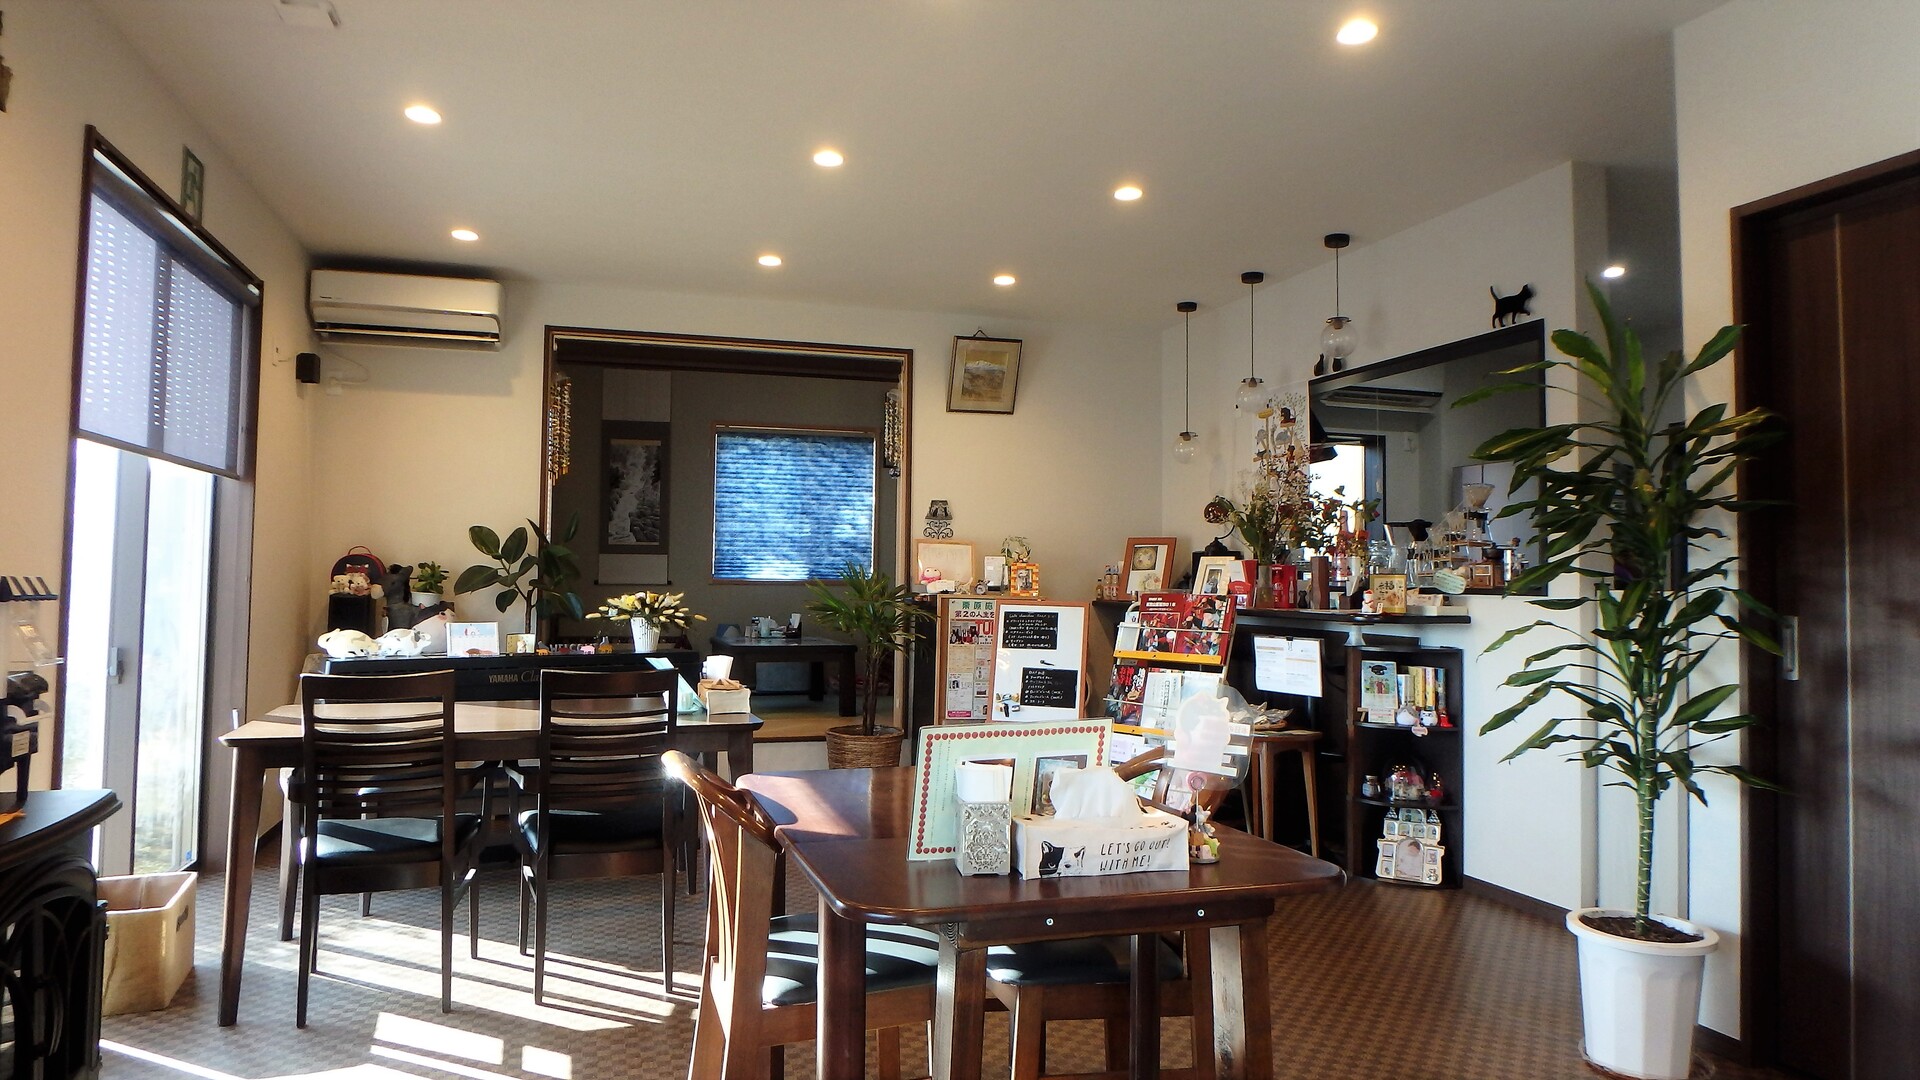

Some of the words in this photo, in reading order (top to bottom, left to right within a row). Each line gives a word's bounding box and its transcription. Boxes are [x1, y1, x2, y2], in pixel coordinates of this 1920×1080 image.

[488, 674, 519, 683] YAMAHA
[520, 669, 540, 682] Cla
[1100, 842, 1130, 856] LET'S
[1134, 840, 1146, 852] GO
[1149, 838, 1171, 850] OUT!
[1099, 858, 1129, 872] WITH
[1131, 854, 1151, 868] ME!
